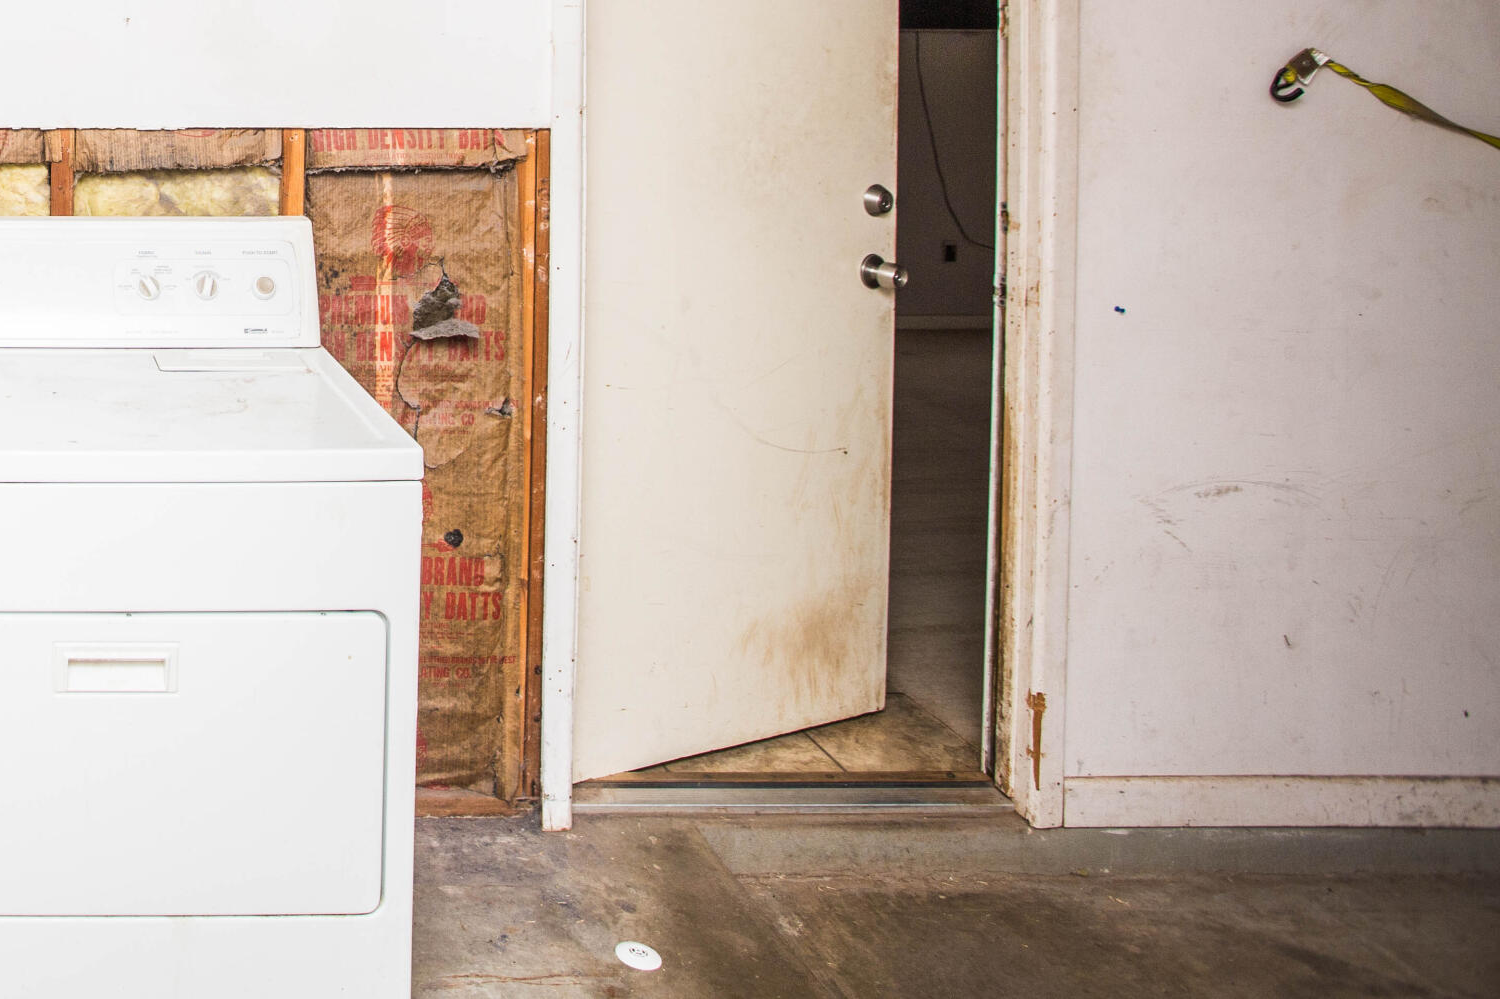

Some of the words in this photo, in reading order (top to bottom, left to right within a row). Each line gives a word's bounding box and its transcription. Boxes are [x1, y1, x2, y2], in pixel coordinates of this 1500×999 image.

[367, 128, 444, 150] DENSITY
[421, 556, 485, 587] BRAND
[445, 591, 503, 621] BATTS
[420, 666, 450, 678] ATING
